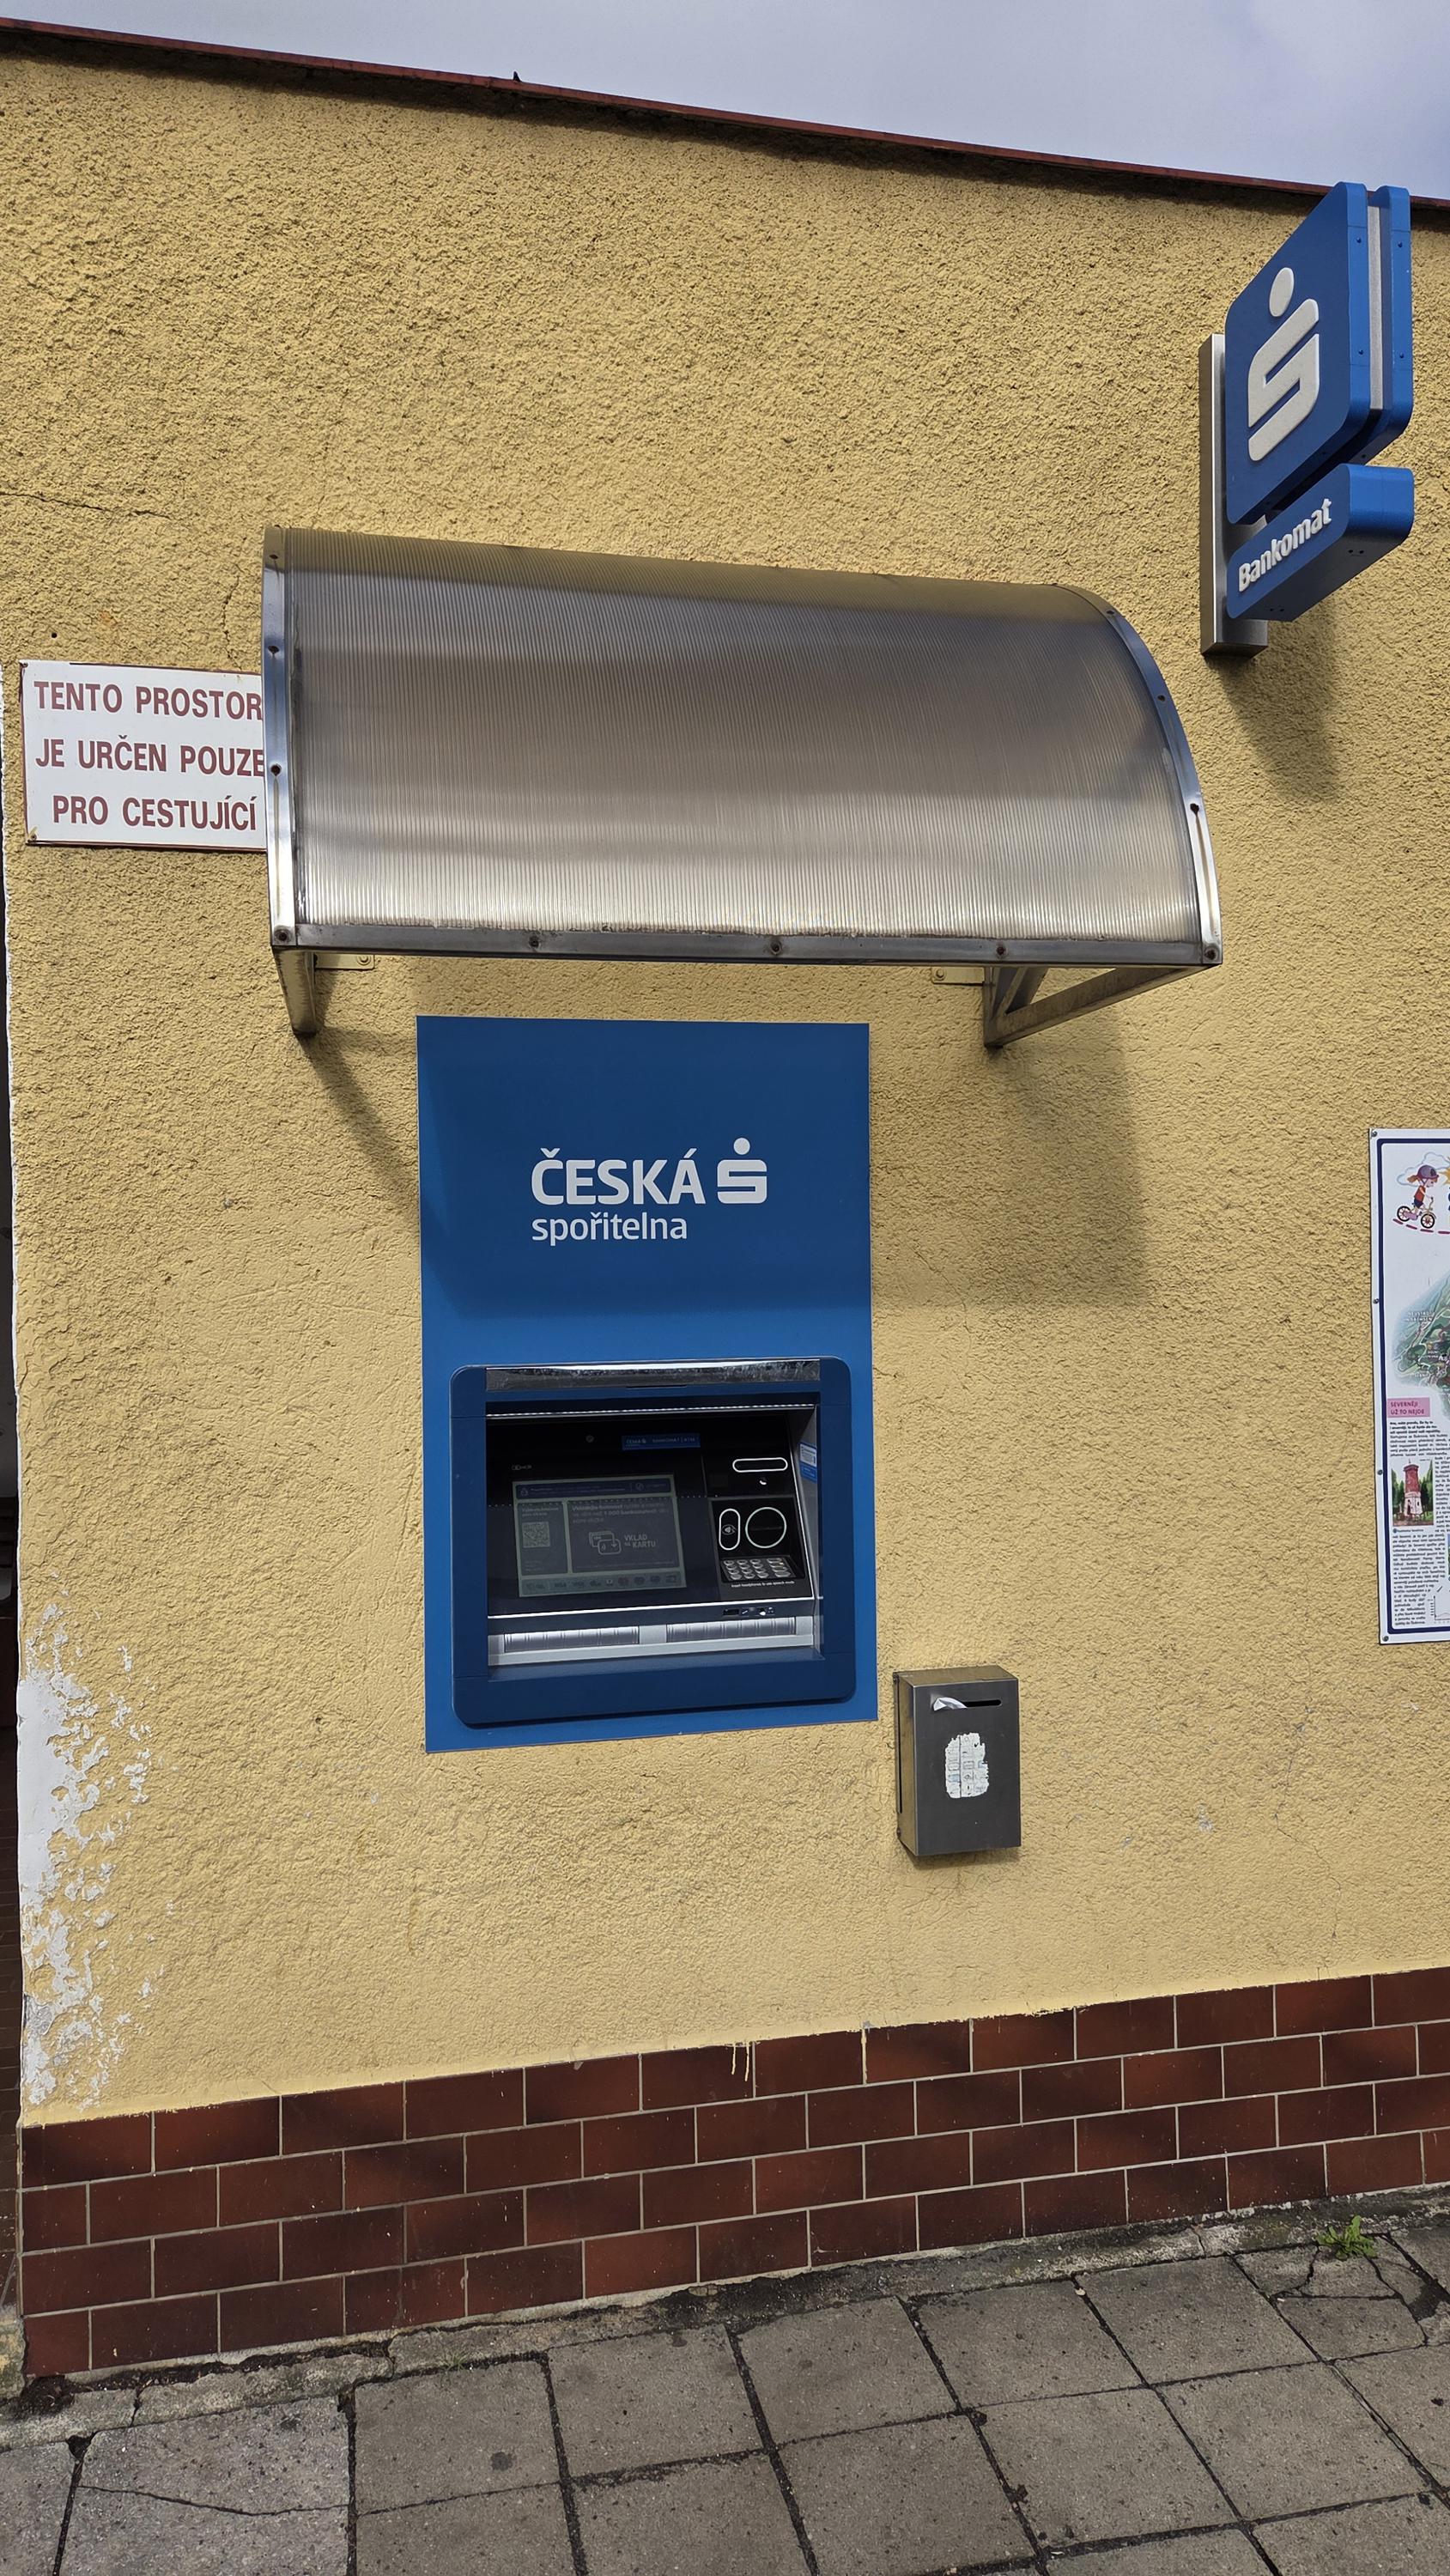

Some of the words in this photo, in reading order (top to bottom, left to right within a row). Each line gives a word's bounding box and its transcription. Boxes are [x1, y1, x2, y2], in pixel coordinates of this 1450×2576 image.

[1239, 498, 1332, 592] Bankomat
[33, 681, 123, 714] TENTO
[136, 686, 264, 721] PROSTOR
[35, 738, 65, 768] JE
[78, 734, 167, 772] URČEN
[180, 744, 264, 777] POUZE
[52, 795, 108, 825] PRO
[122, 795, 258, 831] CESTUJÍCÍ
[531, 1147, 707, 1206] ČESKÁ
[531, 1212, 688, 1247] spořitelna
[632, 1540, 657, 1549] KARTU
